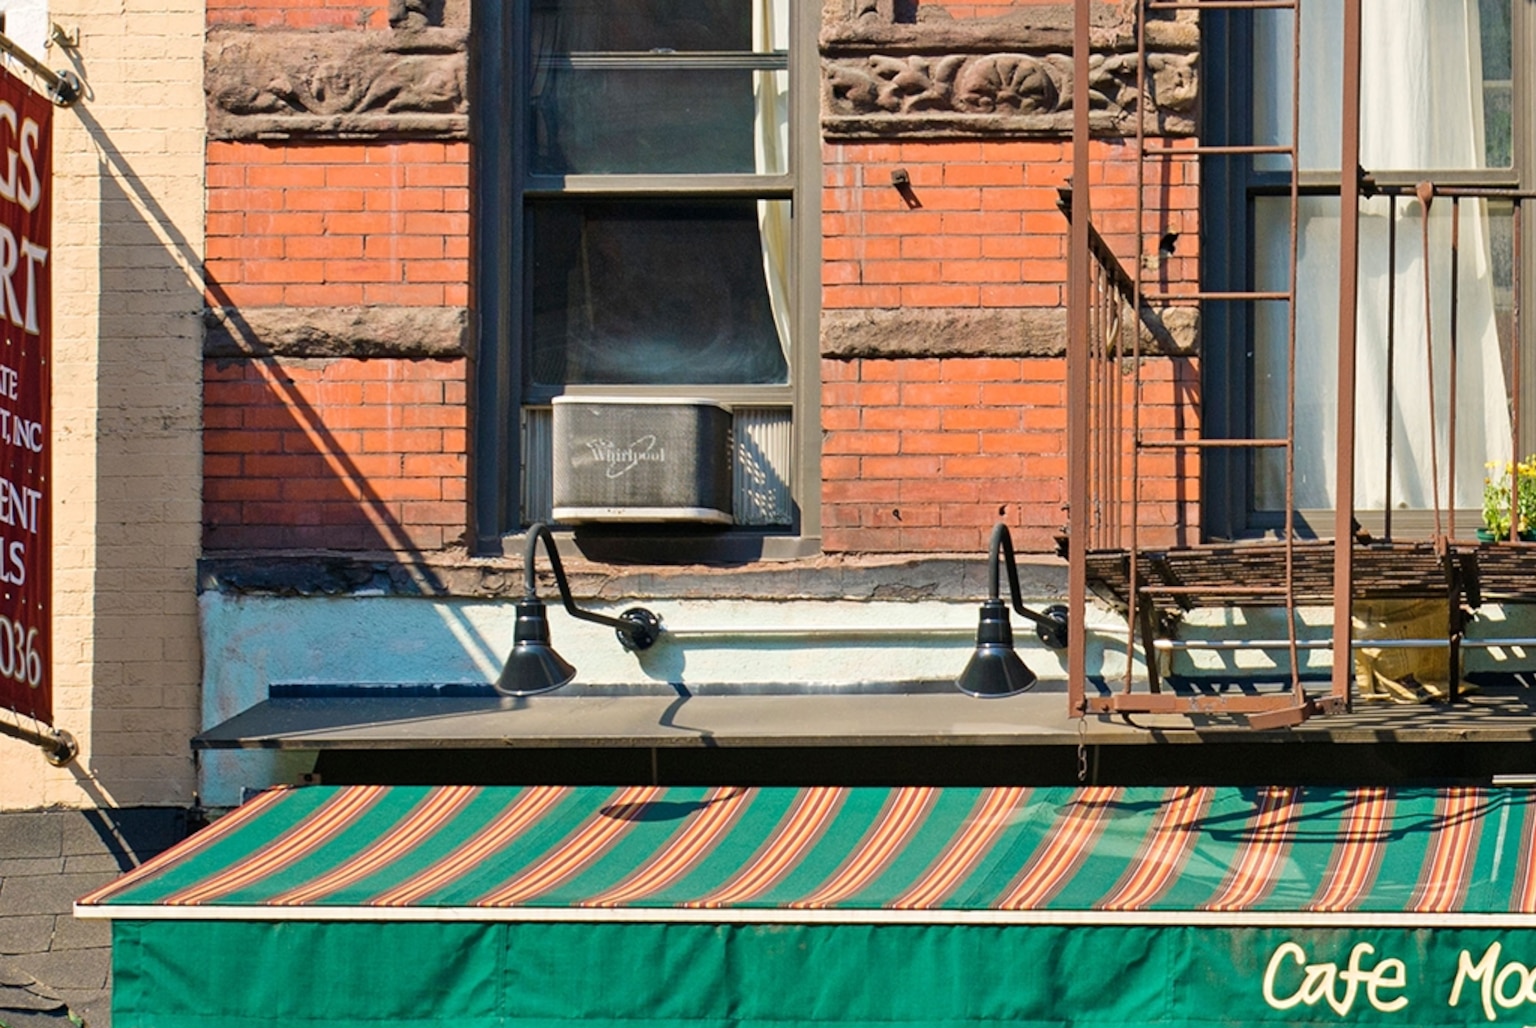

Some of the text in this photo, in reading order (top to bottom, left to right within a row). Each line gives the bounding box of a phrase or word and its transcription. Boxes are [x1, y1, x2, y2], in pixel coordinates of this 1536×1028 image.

[0, 100, 40, 213] GS
[0, 224, 48, 335] RT
[0, 364, 18, 401] TE
[587, 439, 665, 465] Whirlpool
[0, 476, 42, 534] ENT
[0, 614, 42, 689] 036
[1263, 941, 1409, 1016] Cafe
